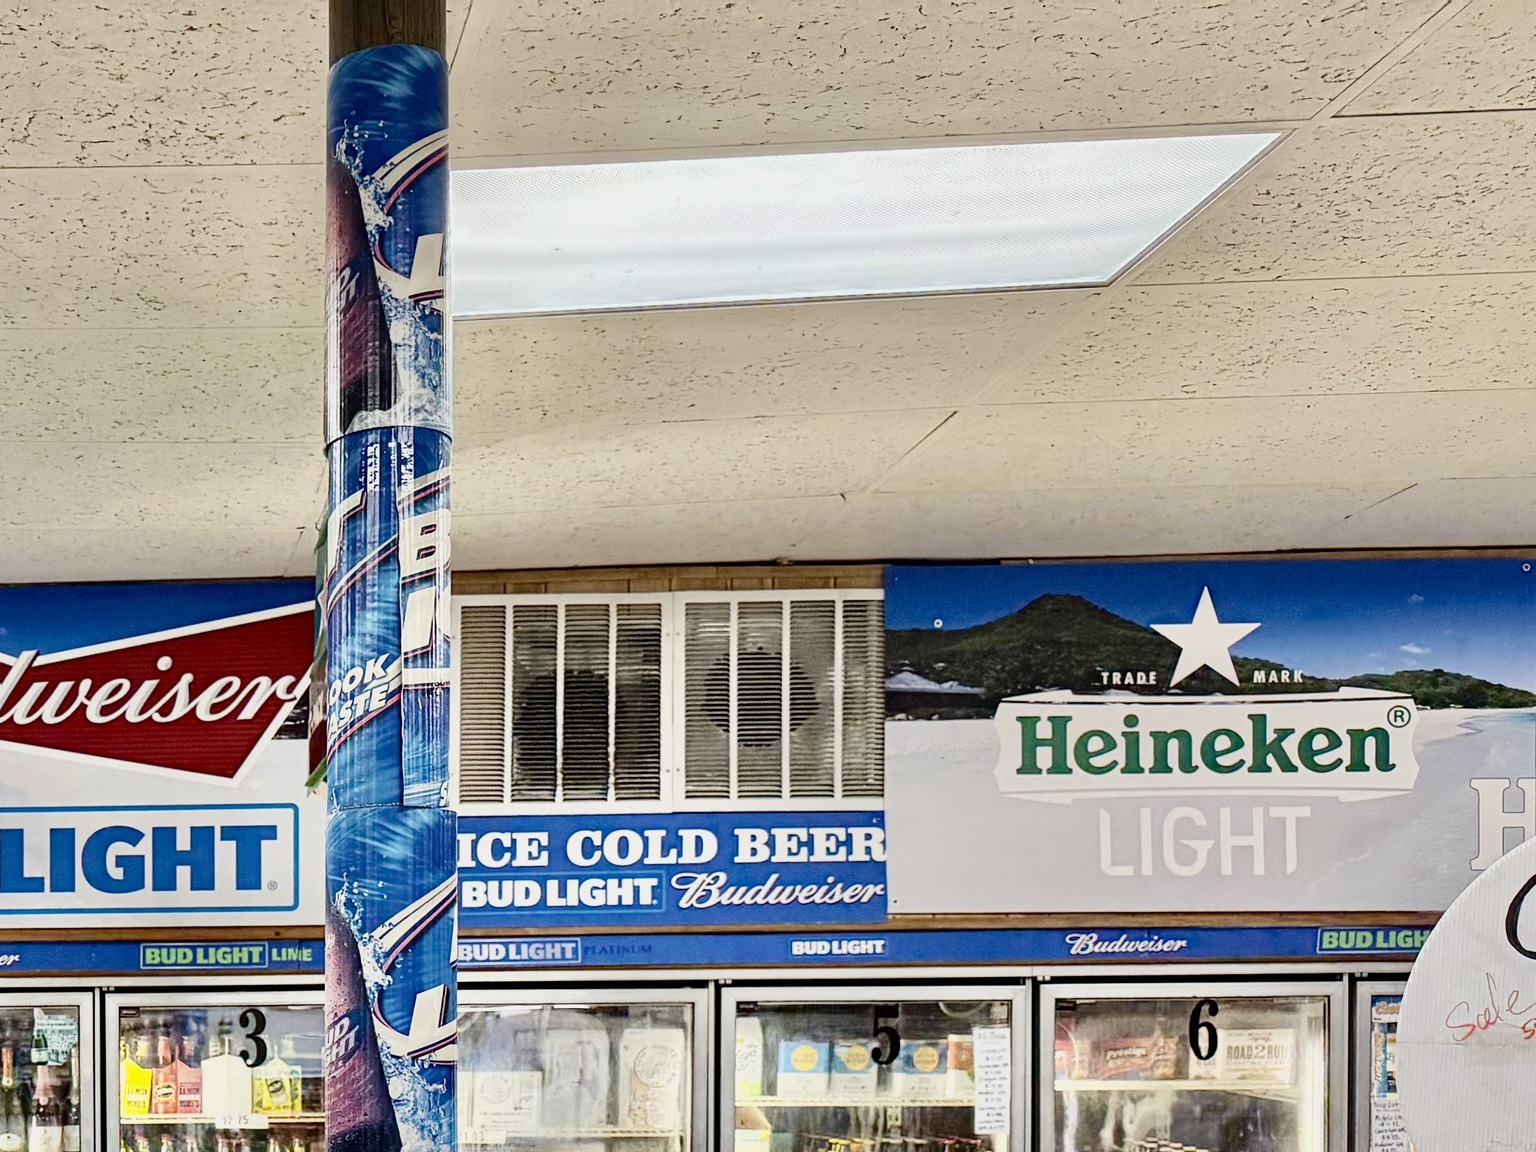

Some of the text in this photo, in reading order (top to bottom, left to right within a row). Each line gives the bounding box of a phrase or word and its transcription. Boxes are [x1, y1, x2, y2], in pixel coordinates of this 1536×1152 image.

[328, 653, 389, 699] OOK
[1102, 669, 1304, 685] TRADE MARK
[328, 682, 391, 741] ASTE
[1016, 714, 1396, 776] Heineken
[458, 827, 886, 868] ICE COLD BEER
[1099, 806, 1312, 876] LIGHT
[469, 872, 885, 908] BUD LIGHT Budweiser
[145, 946, 312, 964] BUD LIGHT LIME
[458, 943, 507, 962] BUD
[509, 942, 577, 961] LIGHT
[792, 940, 886, 955] BUD LIGHT
[1065, 933, 1188, 955] Budweiser
[1322, 929, 1432, 949] BUD LIGH
[239, 1008, 267, 1067] 3
[871, 1003, 901, 1066] 5
[1189, 998, 1219, 1060] 6
[1227, 1043, 1266, 1060] ROAD 2
